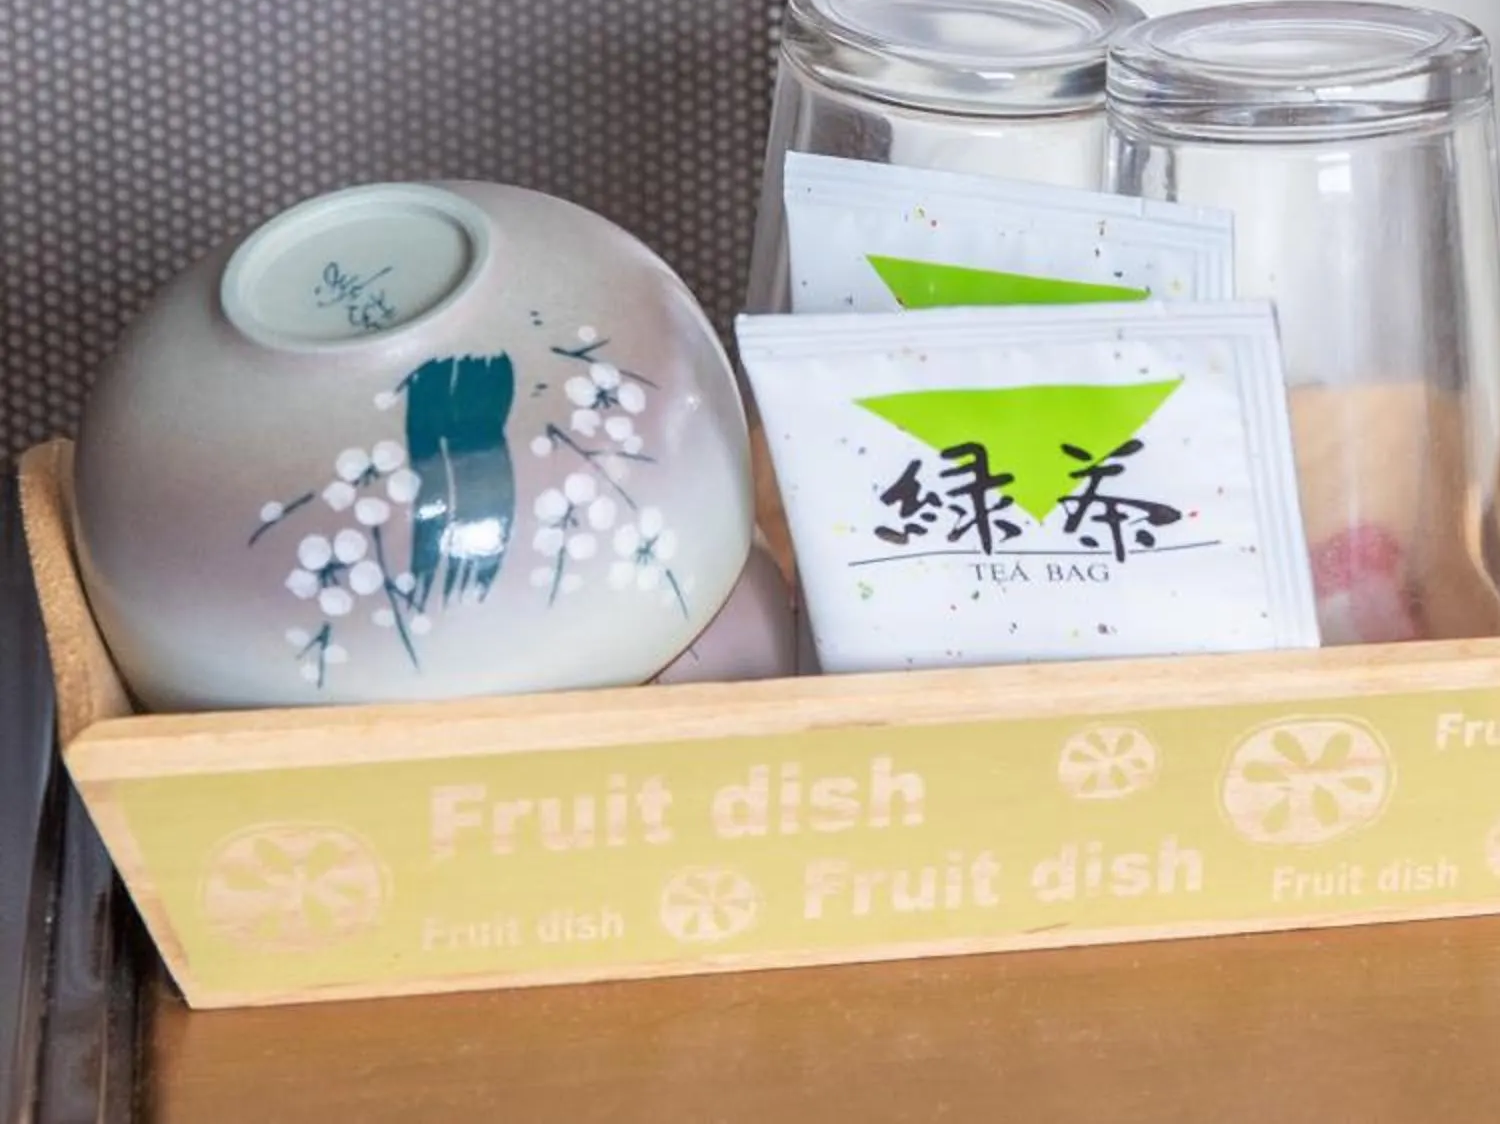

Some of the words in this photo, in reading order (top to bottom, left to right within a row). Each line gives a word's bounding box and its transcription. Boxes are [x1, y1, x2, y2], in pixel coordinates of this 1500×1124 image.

[873, 439, 1184, 564] 緑茶
[969, 561, 1030, 583] TEA
[1046, 562, 1110, 583] BAG
[428, 772, 675, 861] Fruit
[710, 753, 926, 839] dish
[802, 848, 1002, 921] Fruit
[1030, 832, 1205, 905] dish
[1271, 861, 1364, 903] Fruit
[1377, 857, 1460, 894] dish
[420, 910, 522, 952] Fruit
[537, 906, 626, 945] dish
